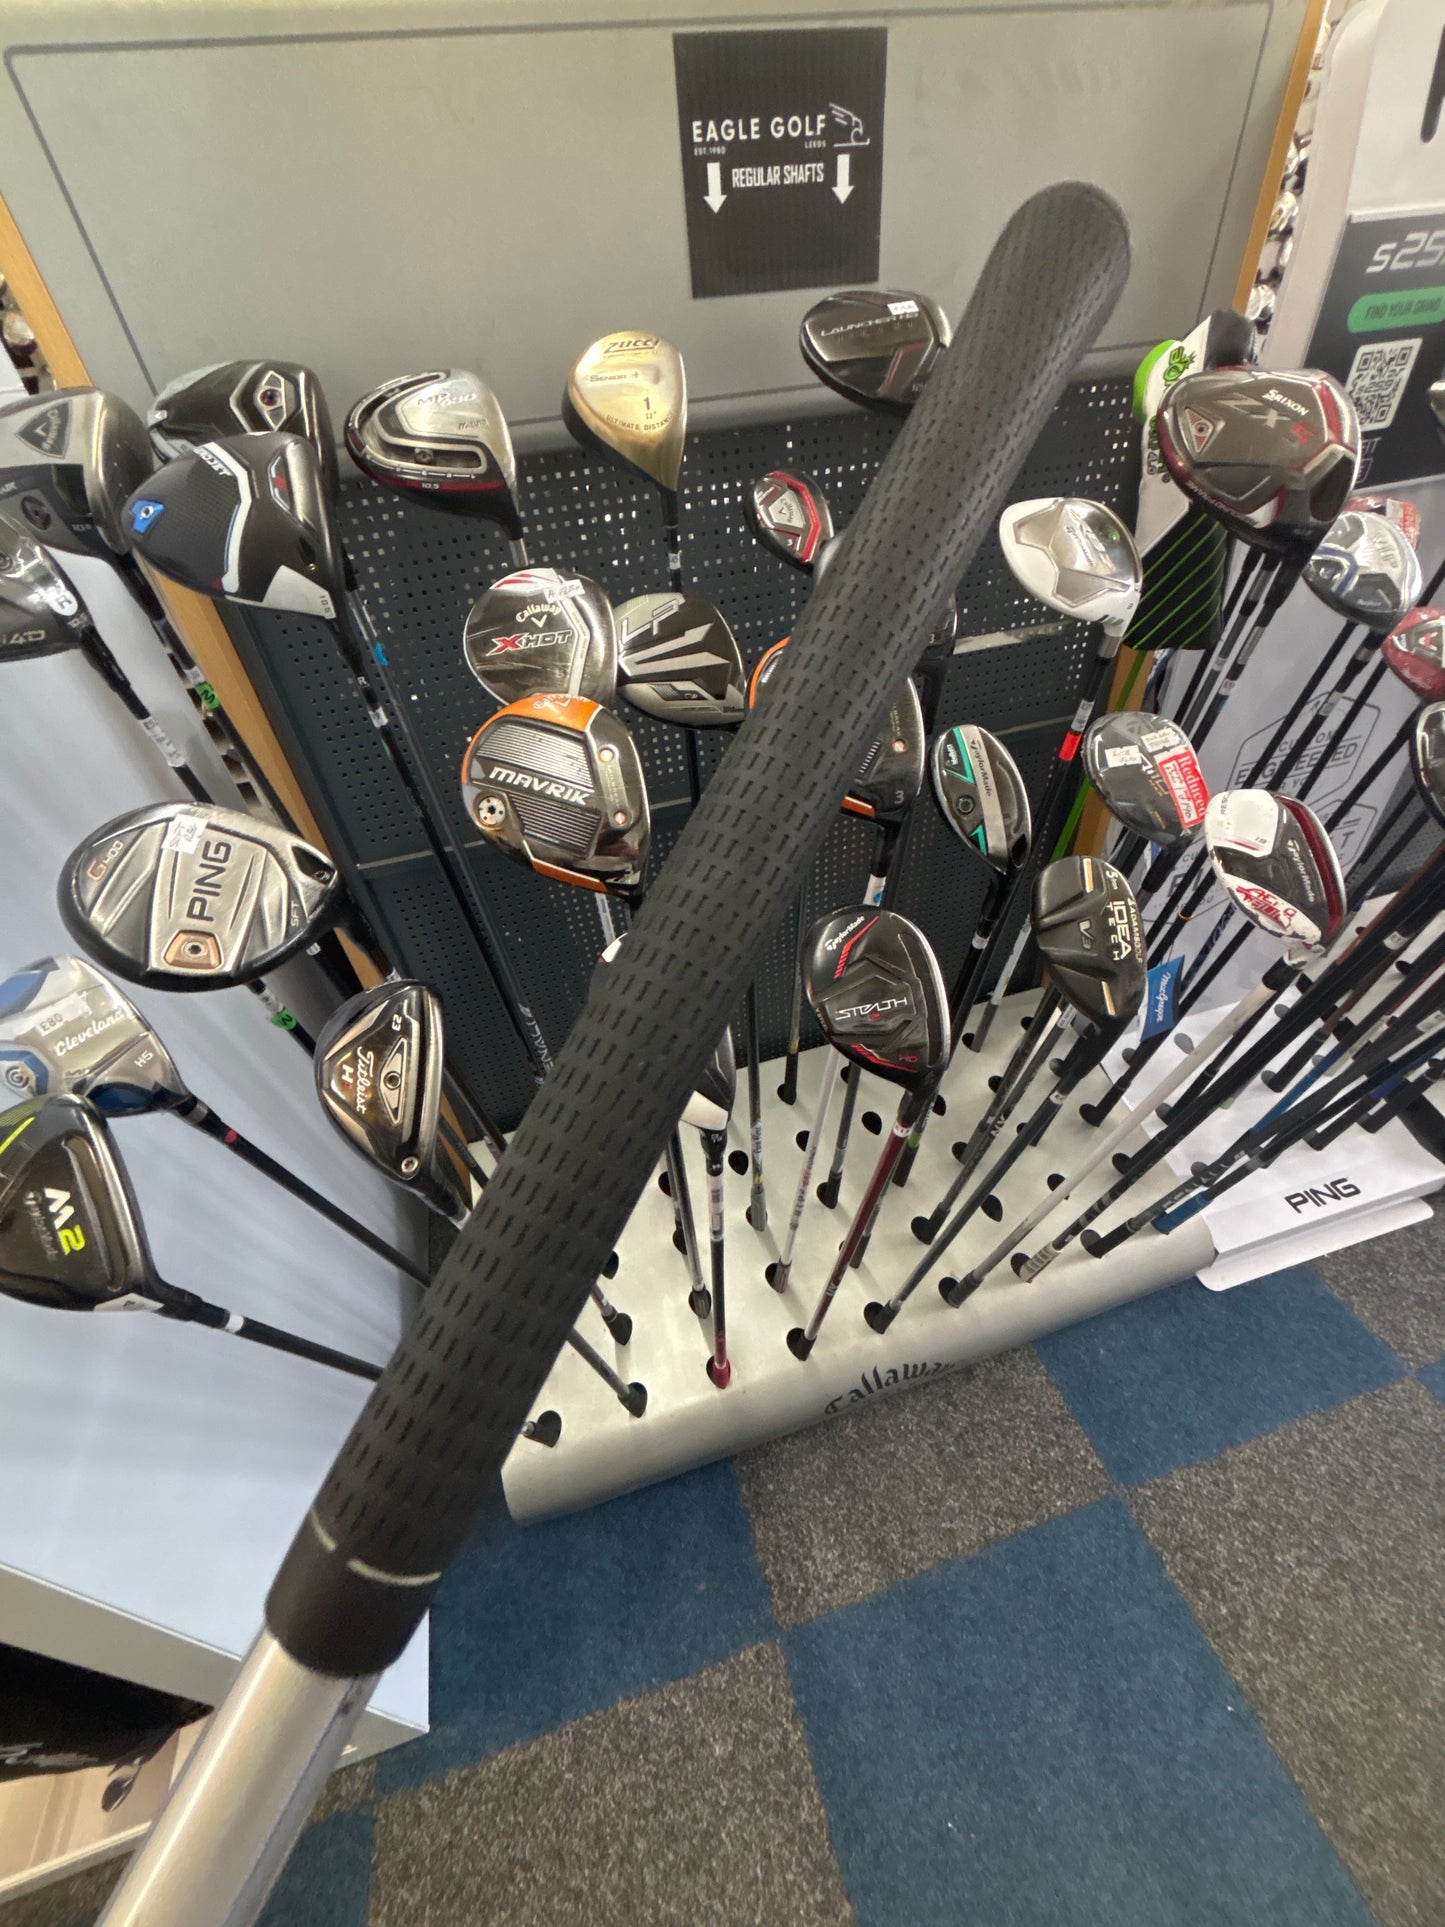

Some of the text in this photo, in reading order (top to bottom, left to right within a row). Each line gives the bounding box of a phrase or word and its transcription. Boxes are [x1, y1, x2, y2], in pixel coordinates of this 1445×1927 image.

[692, 115, 827, 143] EAGLE GOLF
[804, 140, 826, 150] LEEDS
[732, 163, 824, 188] REGULAR SHAFTS
[1388, 302, 1413, 318] YOUR
[1262, 389, 1309, 416] SRIXON
[516, 603, 562, 623] Callaway
[489, 766, 592, 806] MAVRIK
[970, 739, 992, 797] TaylorMade
[1177, 755, 1207, 817] Reduced
[186, 840, 232, 922] PING
[1287, 839, 1315, 903] TaylorMade
[290, 901, 300, 927] SFT
[1105, 901, 1120, 961] TECH
[1111, 900, 1132, 960] IDEA
[825, 915, 865, 951] TaylorMade
[391, 1013, 401, 1032] 23
[835, 996, 908, 1021] STEALTH
[55, 1003, 131, 1057] Cleveland
[355, 1045, 374, 1115] Titleist
[1284, 1177, 1361, 1214] PING
[44, 1187, 86, 1256] M2
